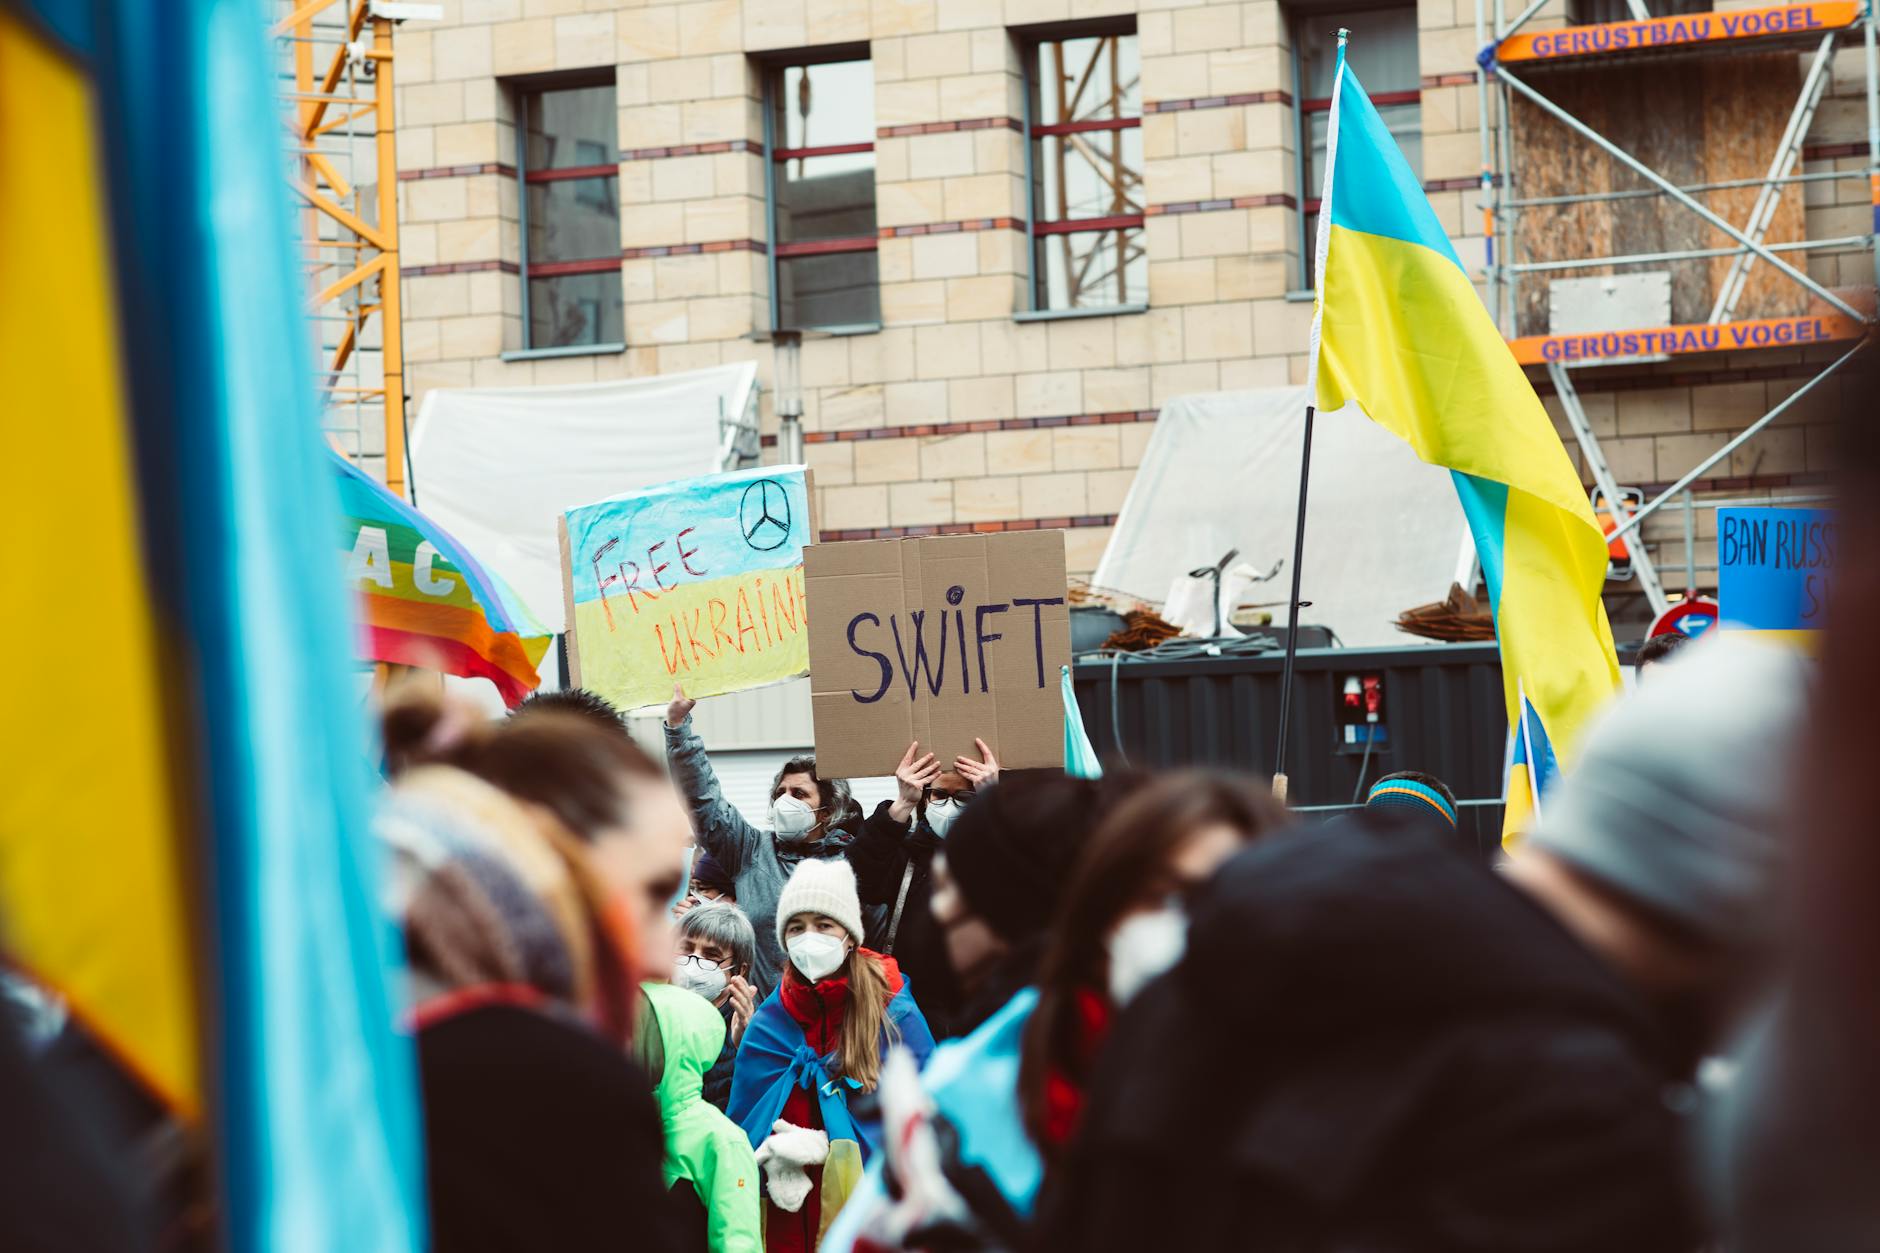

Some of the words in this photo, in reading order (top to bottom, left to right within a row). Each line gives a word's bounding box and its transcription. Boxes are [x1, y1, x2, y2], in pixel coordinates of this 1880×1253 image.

[1531, 18, 1711, 57] GERÜSTBAU
[1721, 7, 1823, 37] VOGEL
[1541, 328, 1720, 362] GERÜSTBAU
[1730, 319, 1831, 347] VOGEL
[347, 525, 456, 597] AC
[1723, 516, 1768, 566] BAN
[1775, 519, 1837, 570] RUSS
[591, 526, 708, 632] FREE
